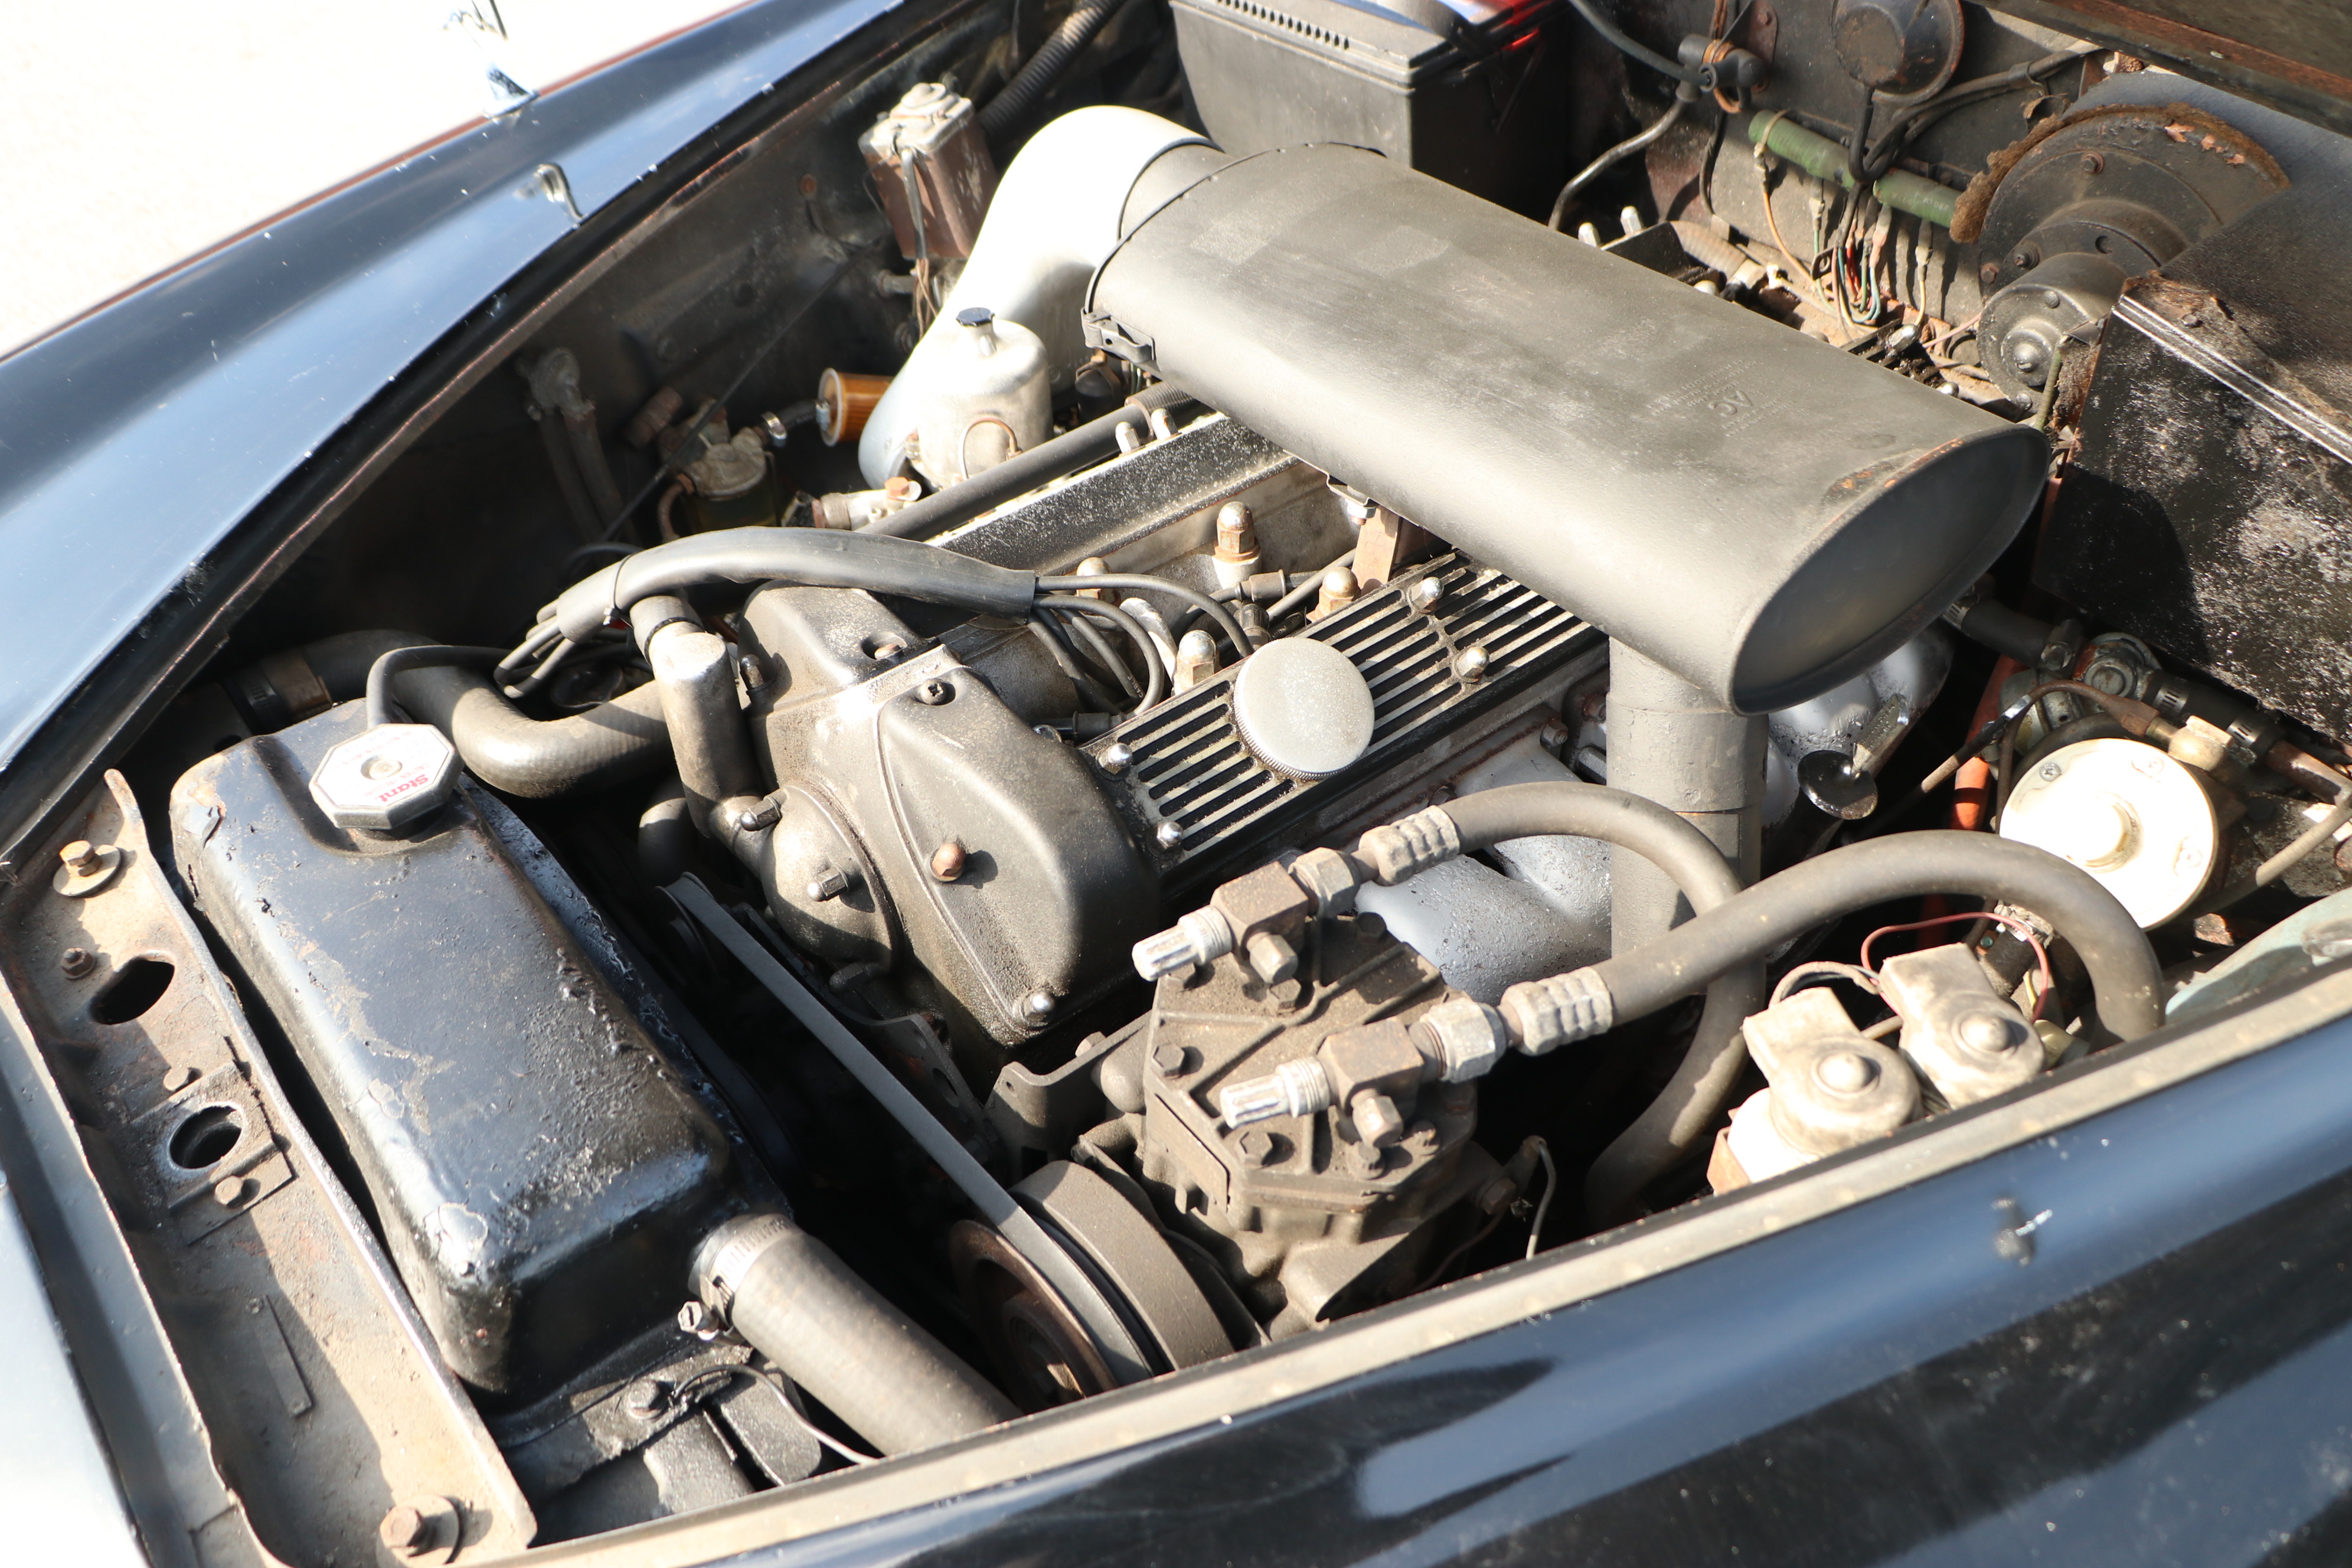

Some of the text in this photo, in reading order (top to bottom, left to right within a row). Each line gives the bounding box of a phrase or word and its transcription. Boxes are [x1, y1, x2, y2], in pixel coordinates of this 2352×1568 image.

[1709, 390, 1753, 417] AC
[1127, 674, 1144, 698] CABLE
[399, 762, 430, 779] CAUTION
[364, 779, 398, 797] PRESSURE
[378, 774, 429, 802] Stant
